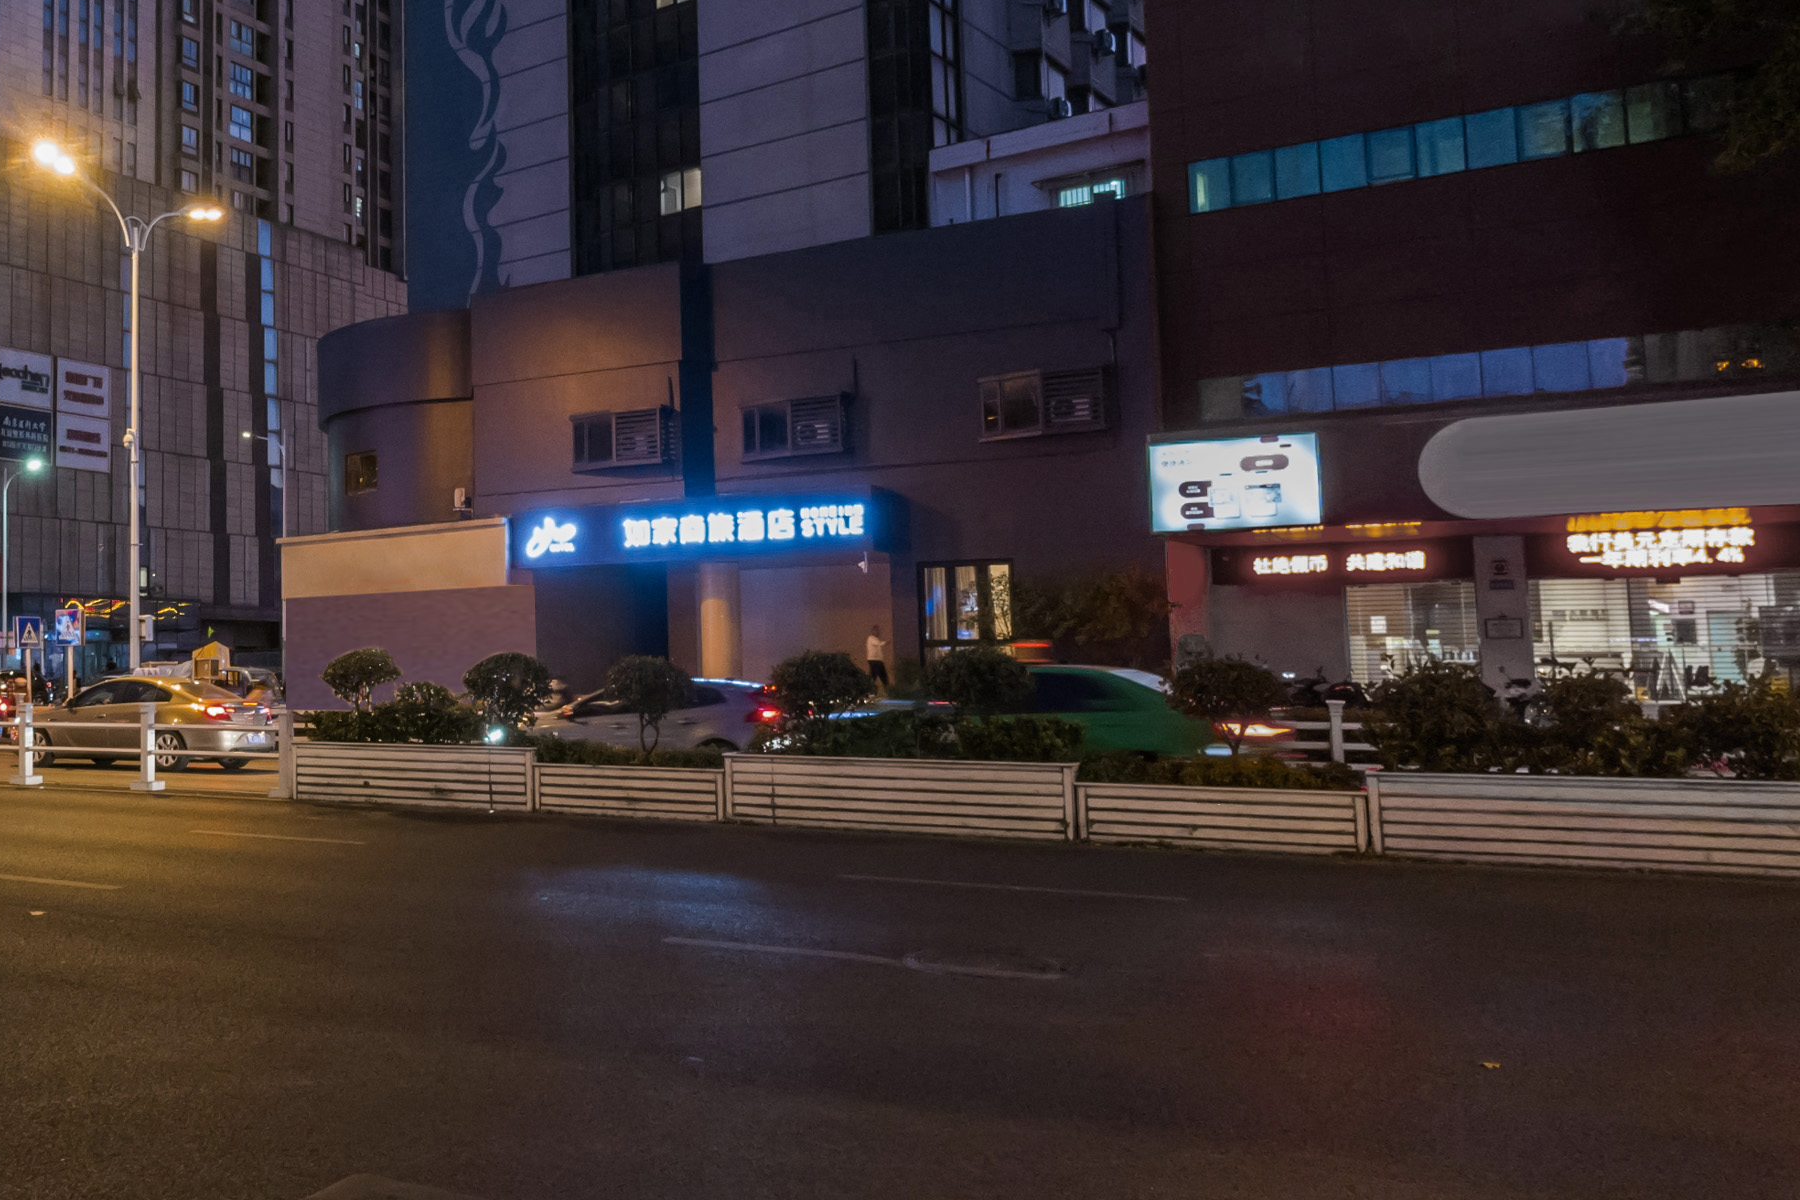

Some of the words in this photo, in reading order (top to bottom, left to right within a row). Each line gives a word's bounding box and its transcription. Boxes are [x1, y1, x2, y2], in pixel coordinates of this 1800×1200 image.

[622, 508, 795, 548] 如家商旅酒店
[800, 516, 864, 538] STYLE
